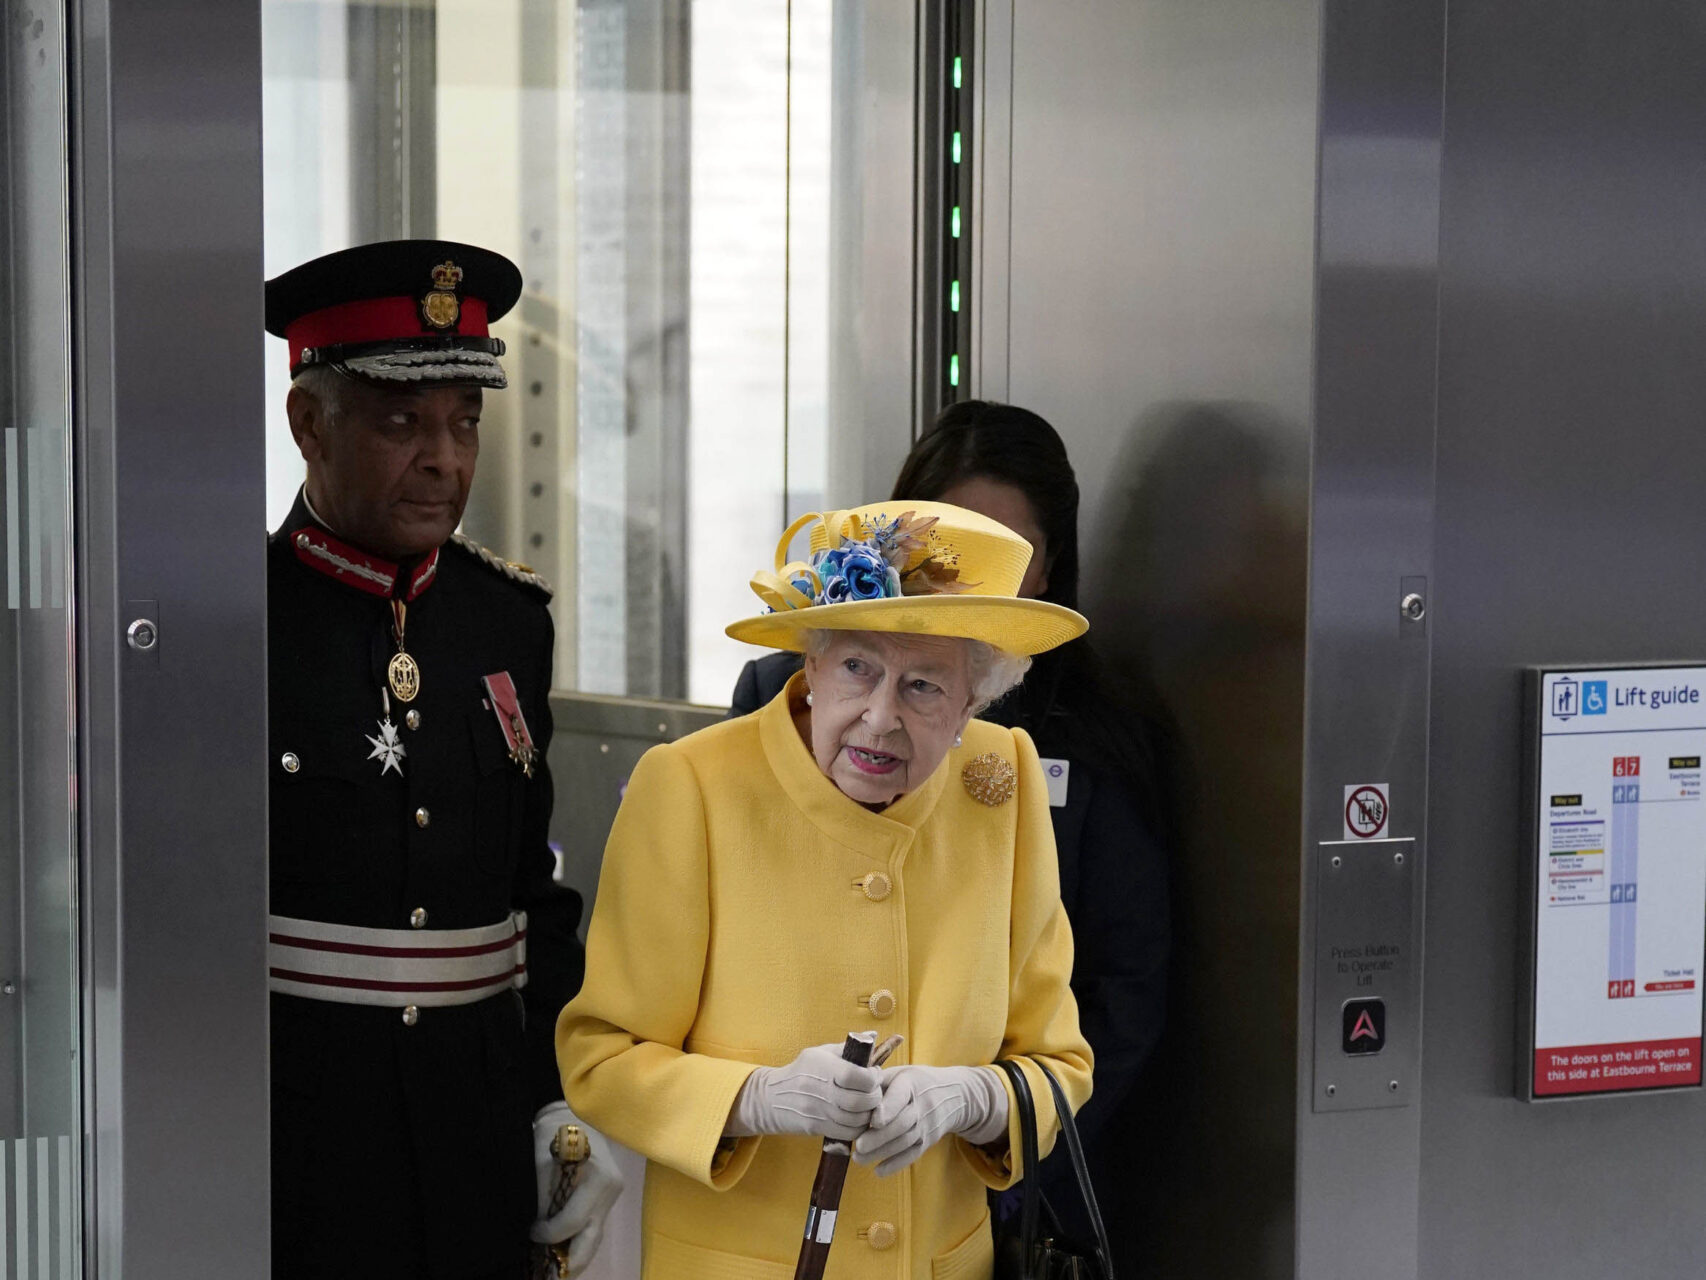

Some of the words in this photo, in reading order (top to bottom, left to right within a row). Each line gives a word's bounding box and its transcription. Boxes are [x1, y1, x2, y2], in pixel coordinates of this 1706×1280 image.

[1615, 687, 1647, 707] Lift
[1650, 686, 1700, 708] guide
[1616, 763, 1624, 777] 6
[1629, 762, 1637, 776] 7
[1331, 947, 1362, 959] Press
[1365, 944, 1400, 957] Button
[1337, 961, 1348, 973] to
[1351, 960, 1393, 974] Operate
[1357, 974, 1373, 986] Lift
[1551, 1055, 1569, 1066] The
[1571, 1053, 1598, 1065] doors
[1601, 1054, 1613, 1063] on
[1615, 1051, 1632, 1062] the
[1634, 1049, 1649, 1060] lift
[1651, 1048, 1675, 1060] open
[1678, 1047, 1690, 1057] on
[1547, 1070, 1566, 1081] this
[1569, 1068, 1587, 1080] side
[1590, 1068, 1600, 1078] at
[1603, 1064, 1656, 1077] Eastbourne
[1659, 1061, 1692, 1073] Terrace
